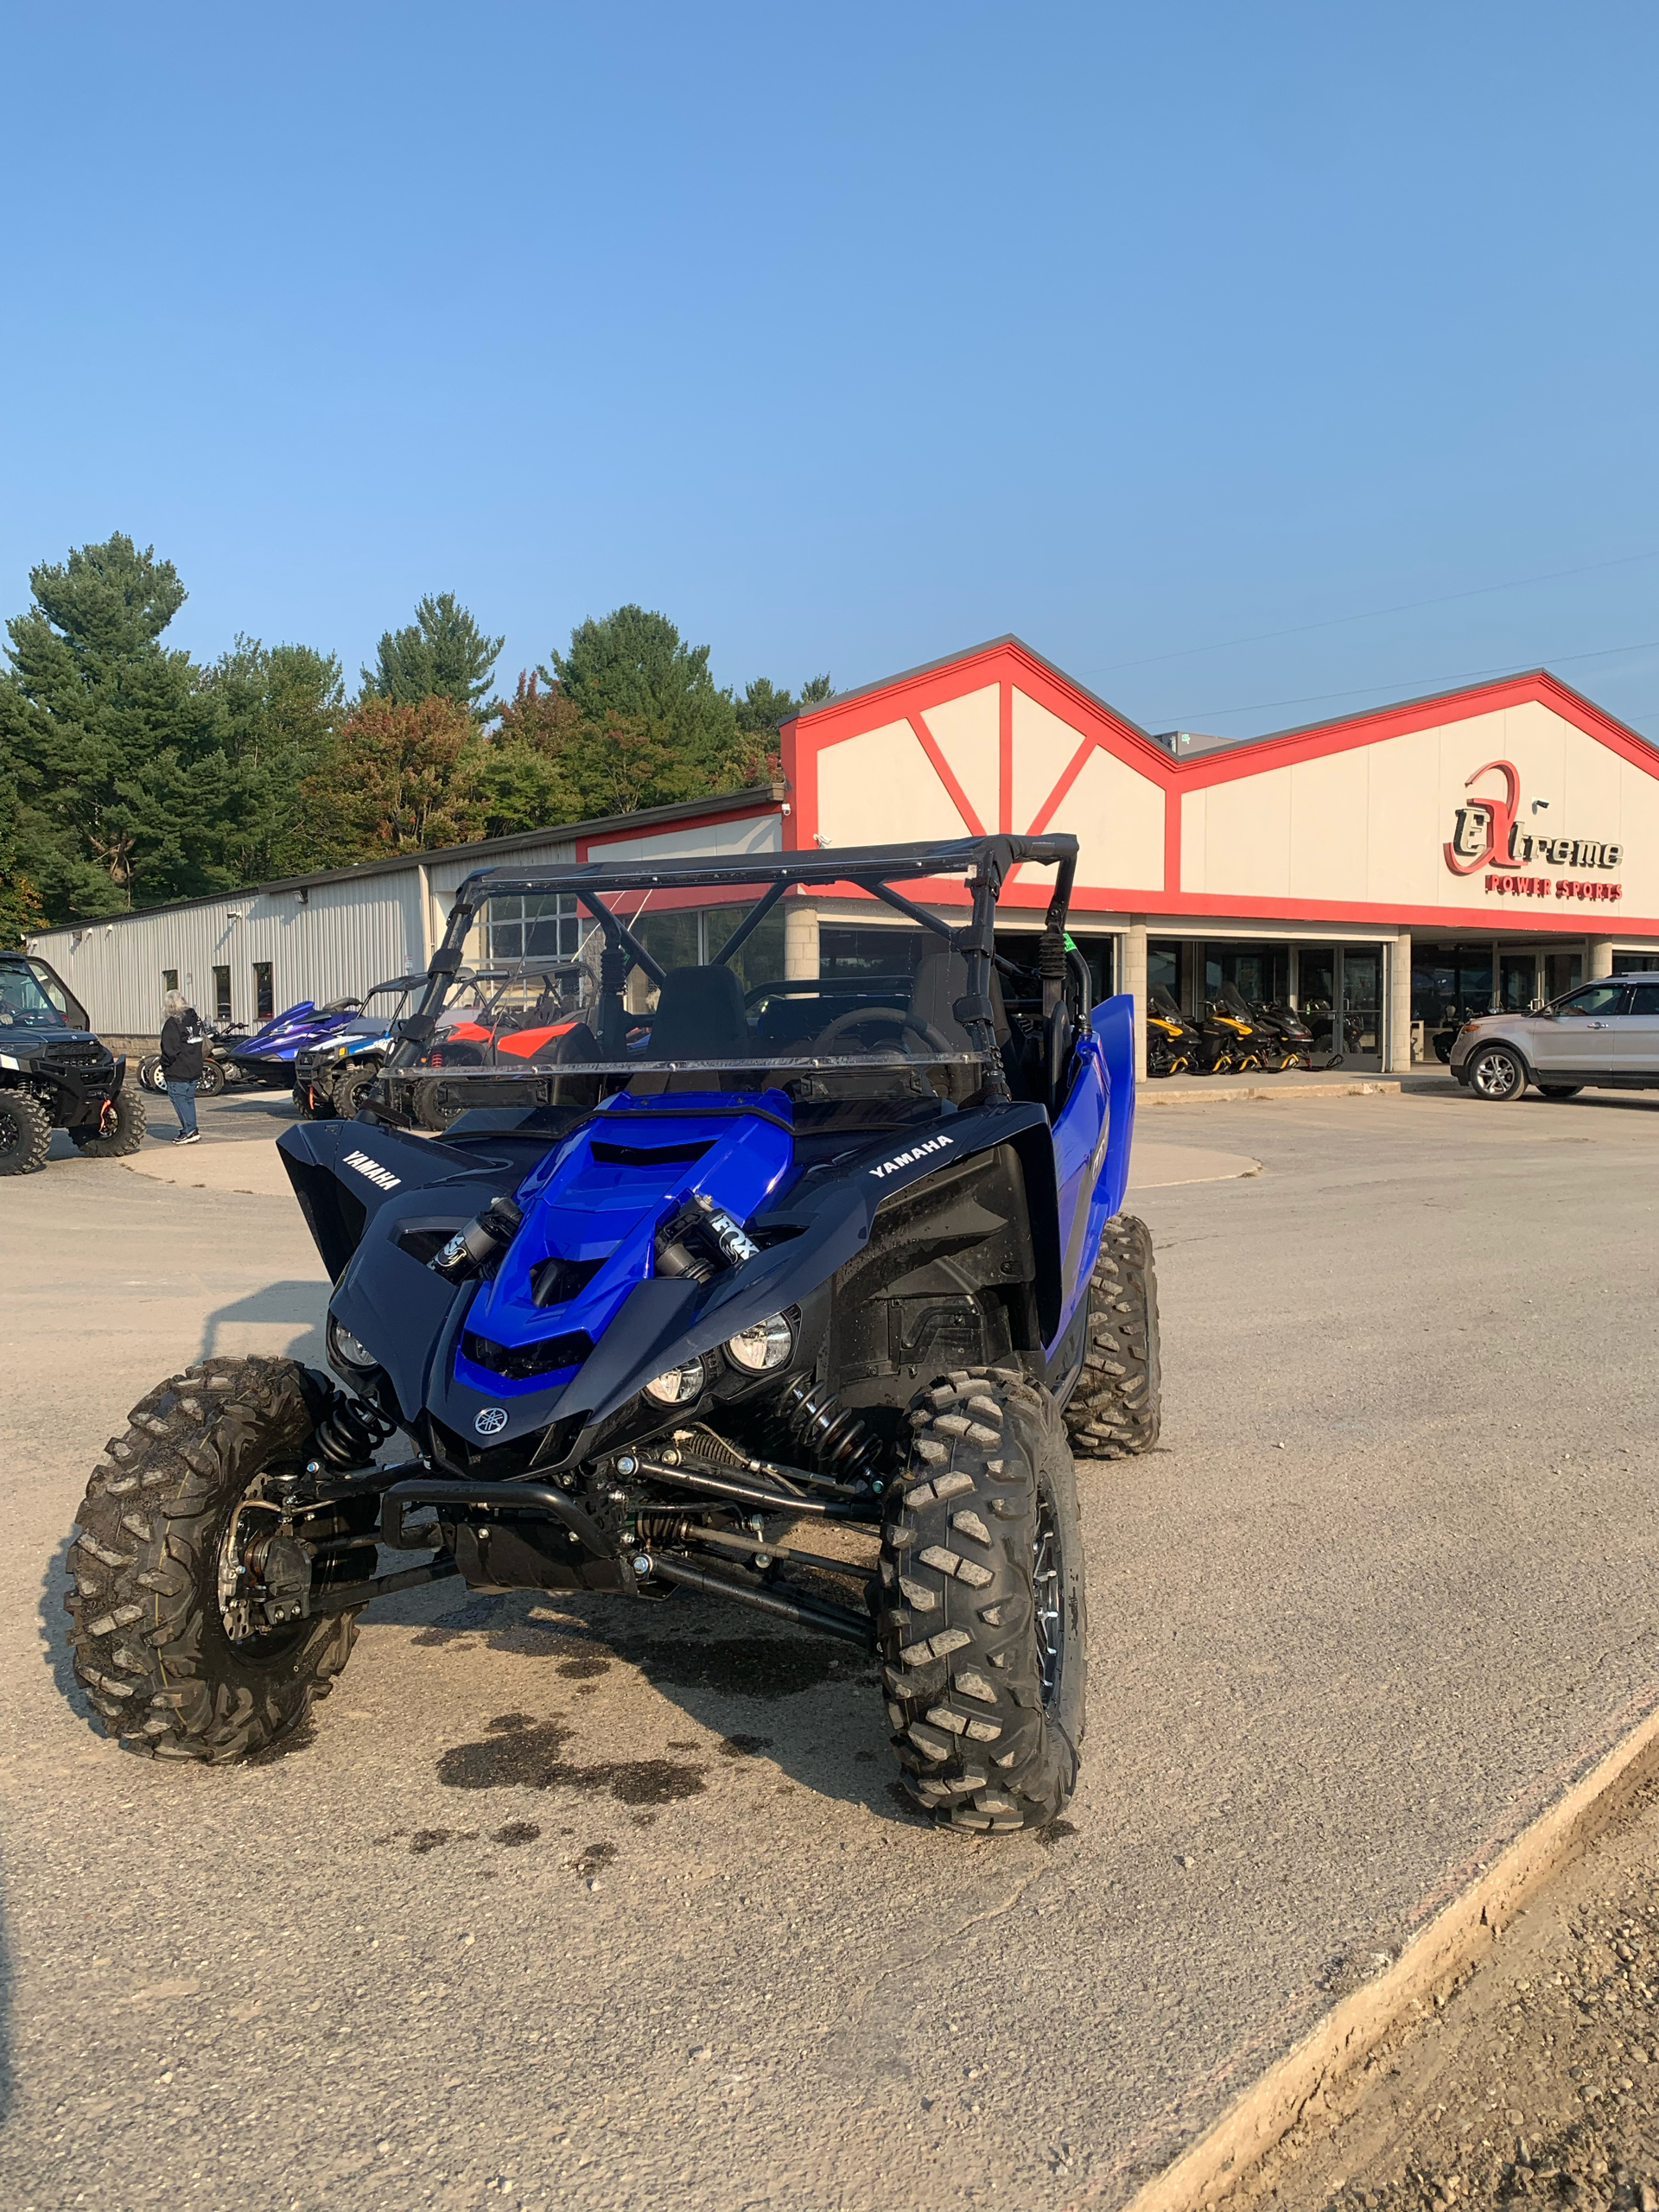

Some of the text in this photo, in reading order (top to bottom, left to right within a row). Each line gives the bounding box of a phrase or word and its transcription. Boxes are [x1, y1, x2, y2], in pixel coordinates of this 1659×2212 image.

[1487, 874, 1623, 900] POWER SPORTS
[342, 1150, 402, 1191] YAMAHA
[868, 1135, 954, 1178] YAMAHA
[711, 1214, 760, 1265] FOX
